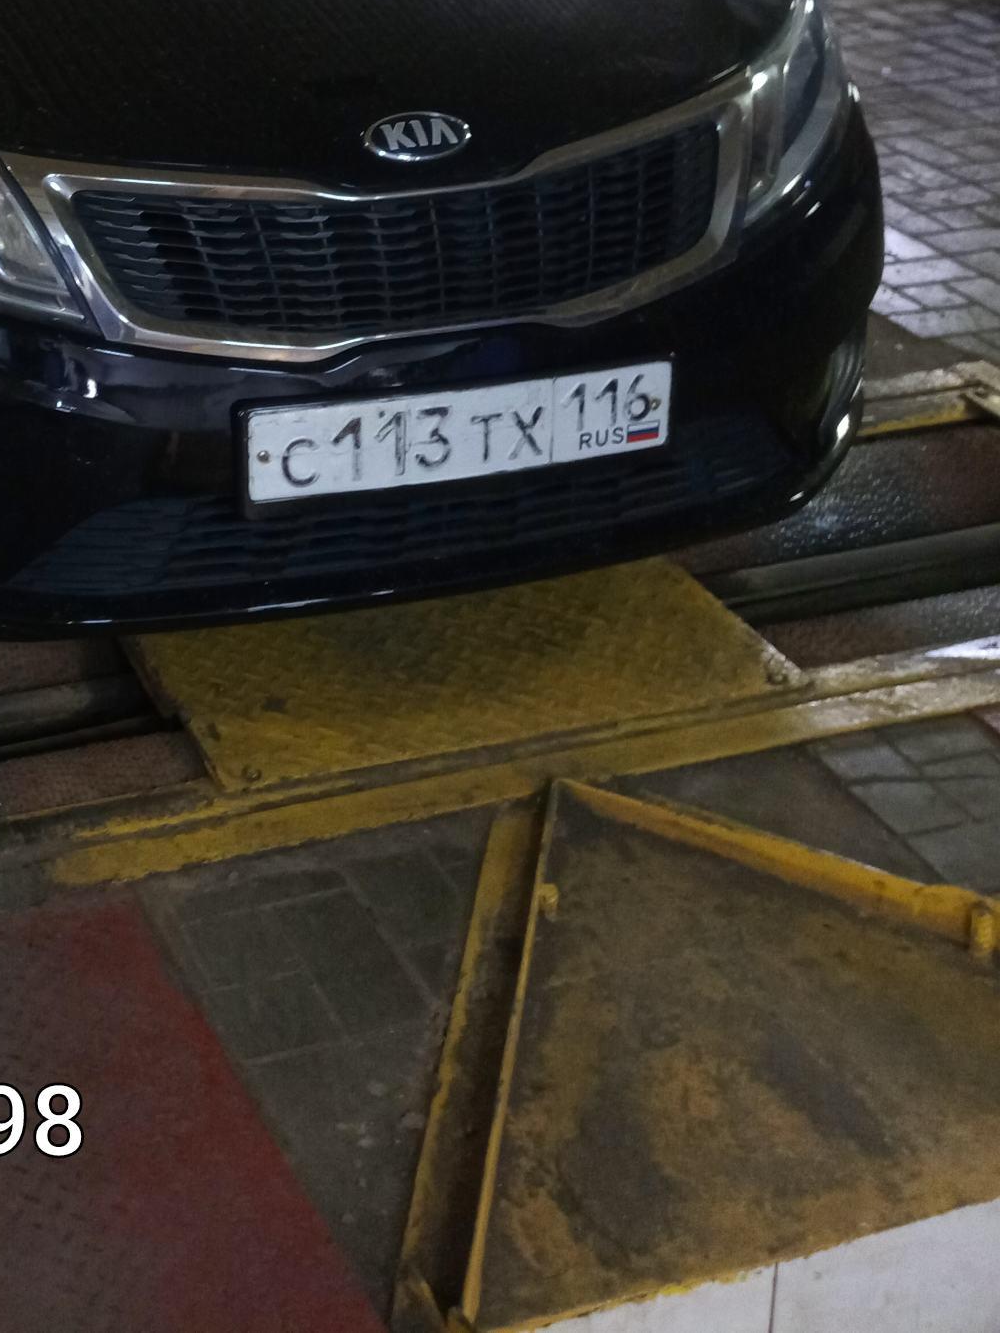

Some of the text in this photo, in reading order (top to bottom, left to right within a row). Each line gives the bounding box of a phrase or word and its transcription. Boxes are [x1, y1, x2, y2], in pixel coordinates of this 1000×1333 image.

[379, 117, 459, 151] KIA
[563, 373, 651, 432] 116
[578, 426, 625, 451] RUS
